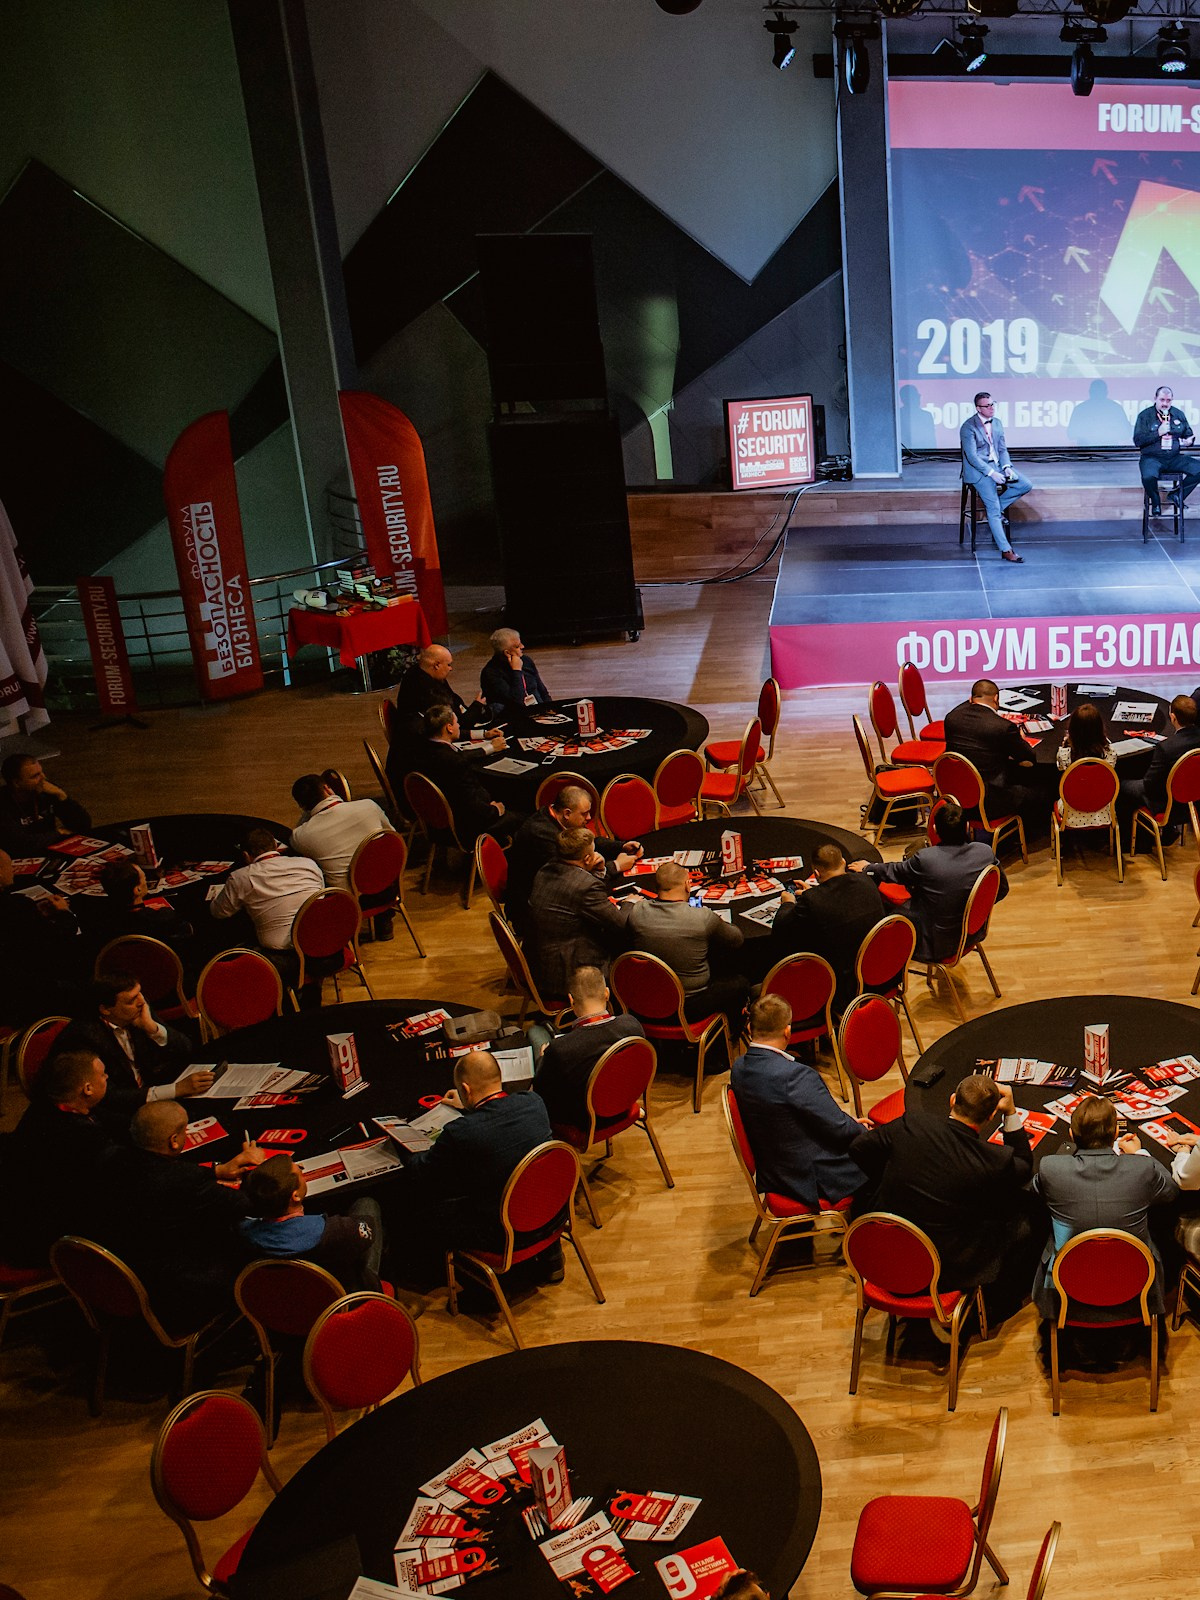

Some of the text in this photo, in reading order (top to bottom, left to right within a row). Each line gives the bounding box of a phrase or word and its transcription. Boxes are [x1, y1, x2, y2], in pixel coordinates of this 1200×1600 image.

[916, 318, 1039, 375] 2019
[738, 433, 806, 458] SECURITY
[752, 407, 806, 432] FORUM
[180, 504, 201, 580] ФОРУМ
[376, 464, 420, 603] UM-SECURITY.RU
[194, 503, 234, 673] БЕЗОПАСНОСТЬ
[87, 585, 128, 705] FORUM-SECURITY.RU
[226, 573, 254, 669] БИЗНЕСА
[896, 627, 1036, 673] ФОРУМ
[542, 1458, 562, 1508] 9
[657, 1554, 697, 1600] 9
[694, 1558, 727, 1575] УЧАСТНИКА
